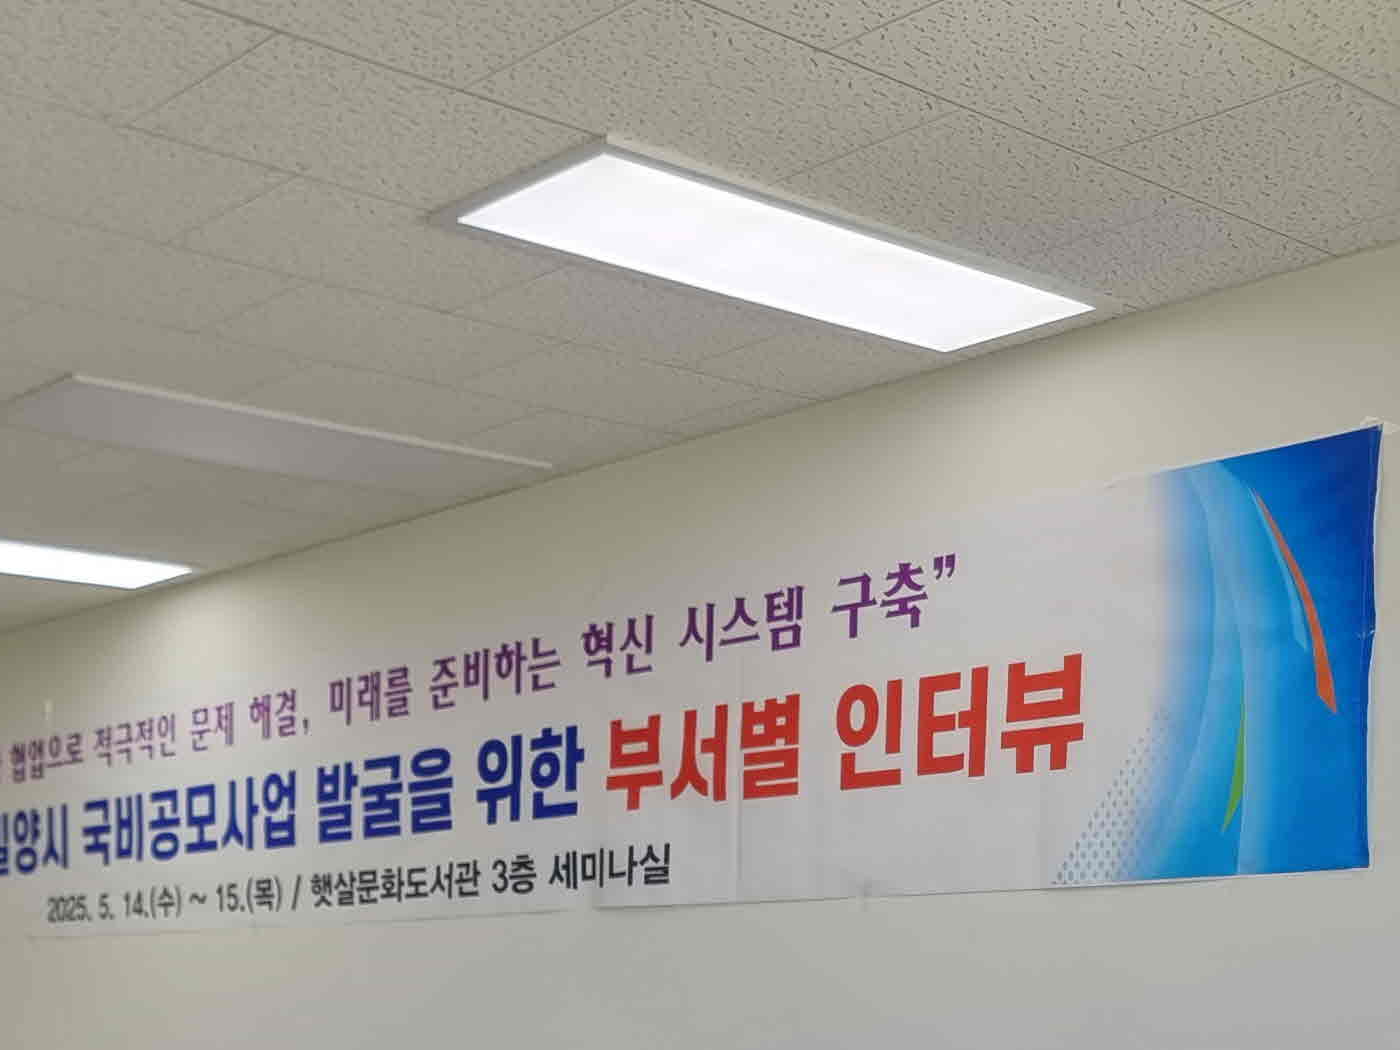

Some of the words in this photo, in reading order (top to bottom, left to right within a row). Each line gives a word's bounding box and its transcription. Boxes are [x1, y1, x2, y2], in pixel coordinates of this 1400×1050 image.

[10, 732, 84, 783] 협업으로
[95, 713, 176, 768] 적극적인
[190, 701, 235, 752] 문제
[249, 688, 311, 739] 해결,
[328, 665, 413, 727] 미래를
[429, 637, 561, 711] 준비하는
[582, 614, 655, 679] 혁신
[679, 585, 805, 663] 시스템
[82, 770, 298, 867] 국비공모사업
[315, 746, 454, 844] 발굴을
[476, 724, 585, 824] 위한
[606, 693, 801, 811] 부서별
[835, 653, 1085, 792] 인터뷰
[48, 894, 93, 924] 2025.
[309, 858, 482, 908] 햇살문화도서관
[491, 853, 538, 895] 3층
[549, 842, 672, 891] 세미나실
